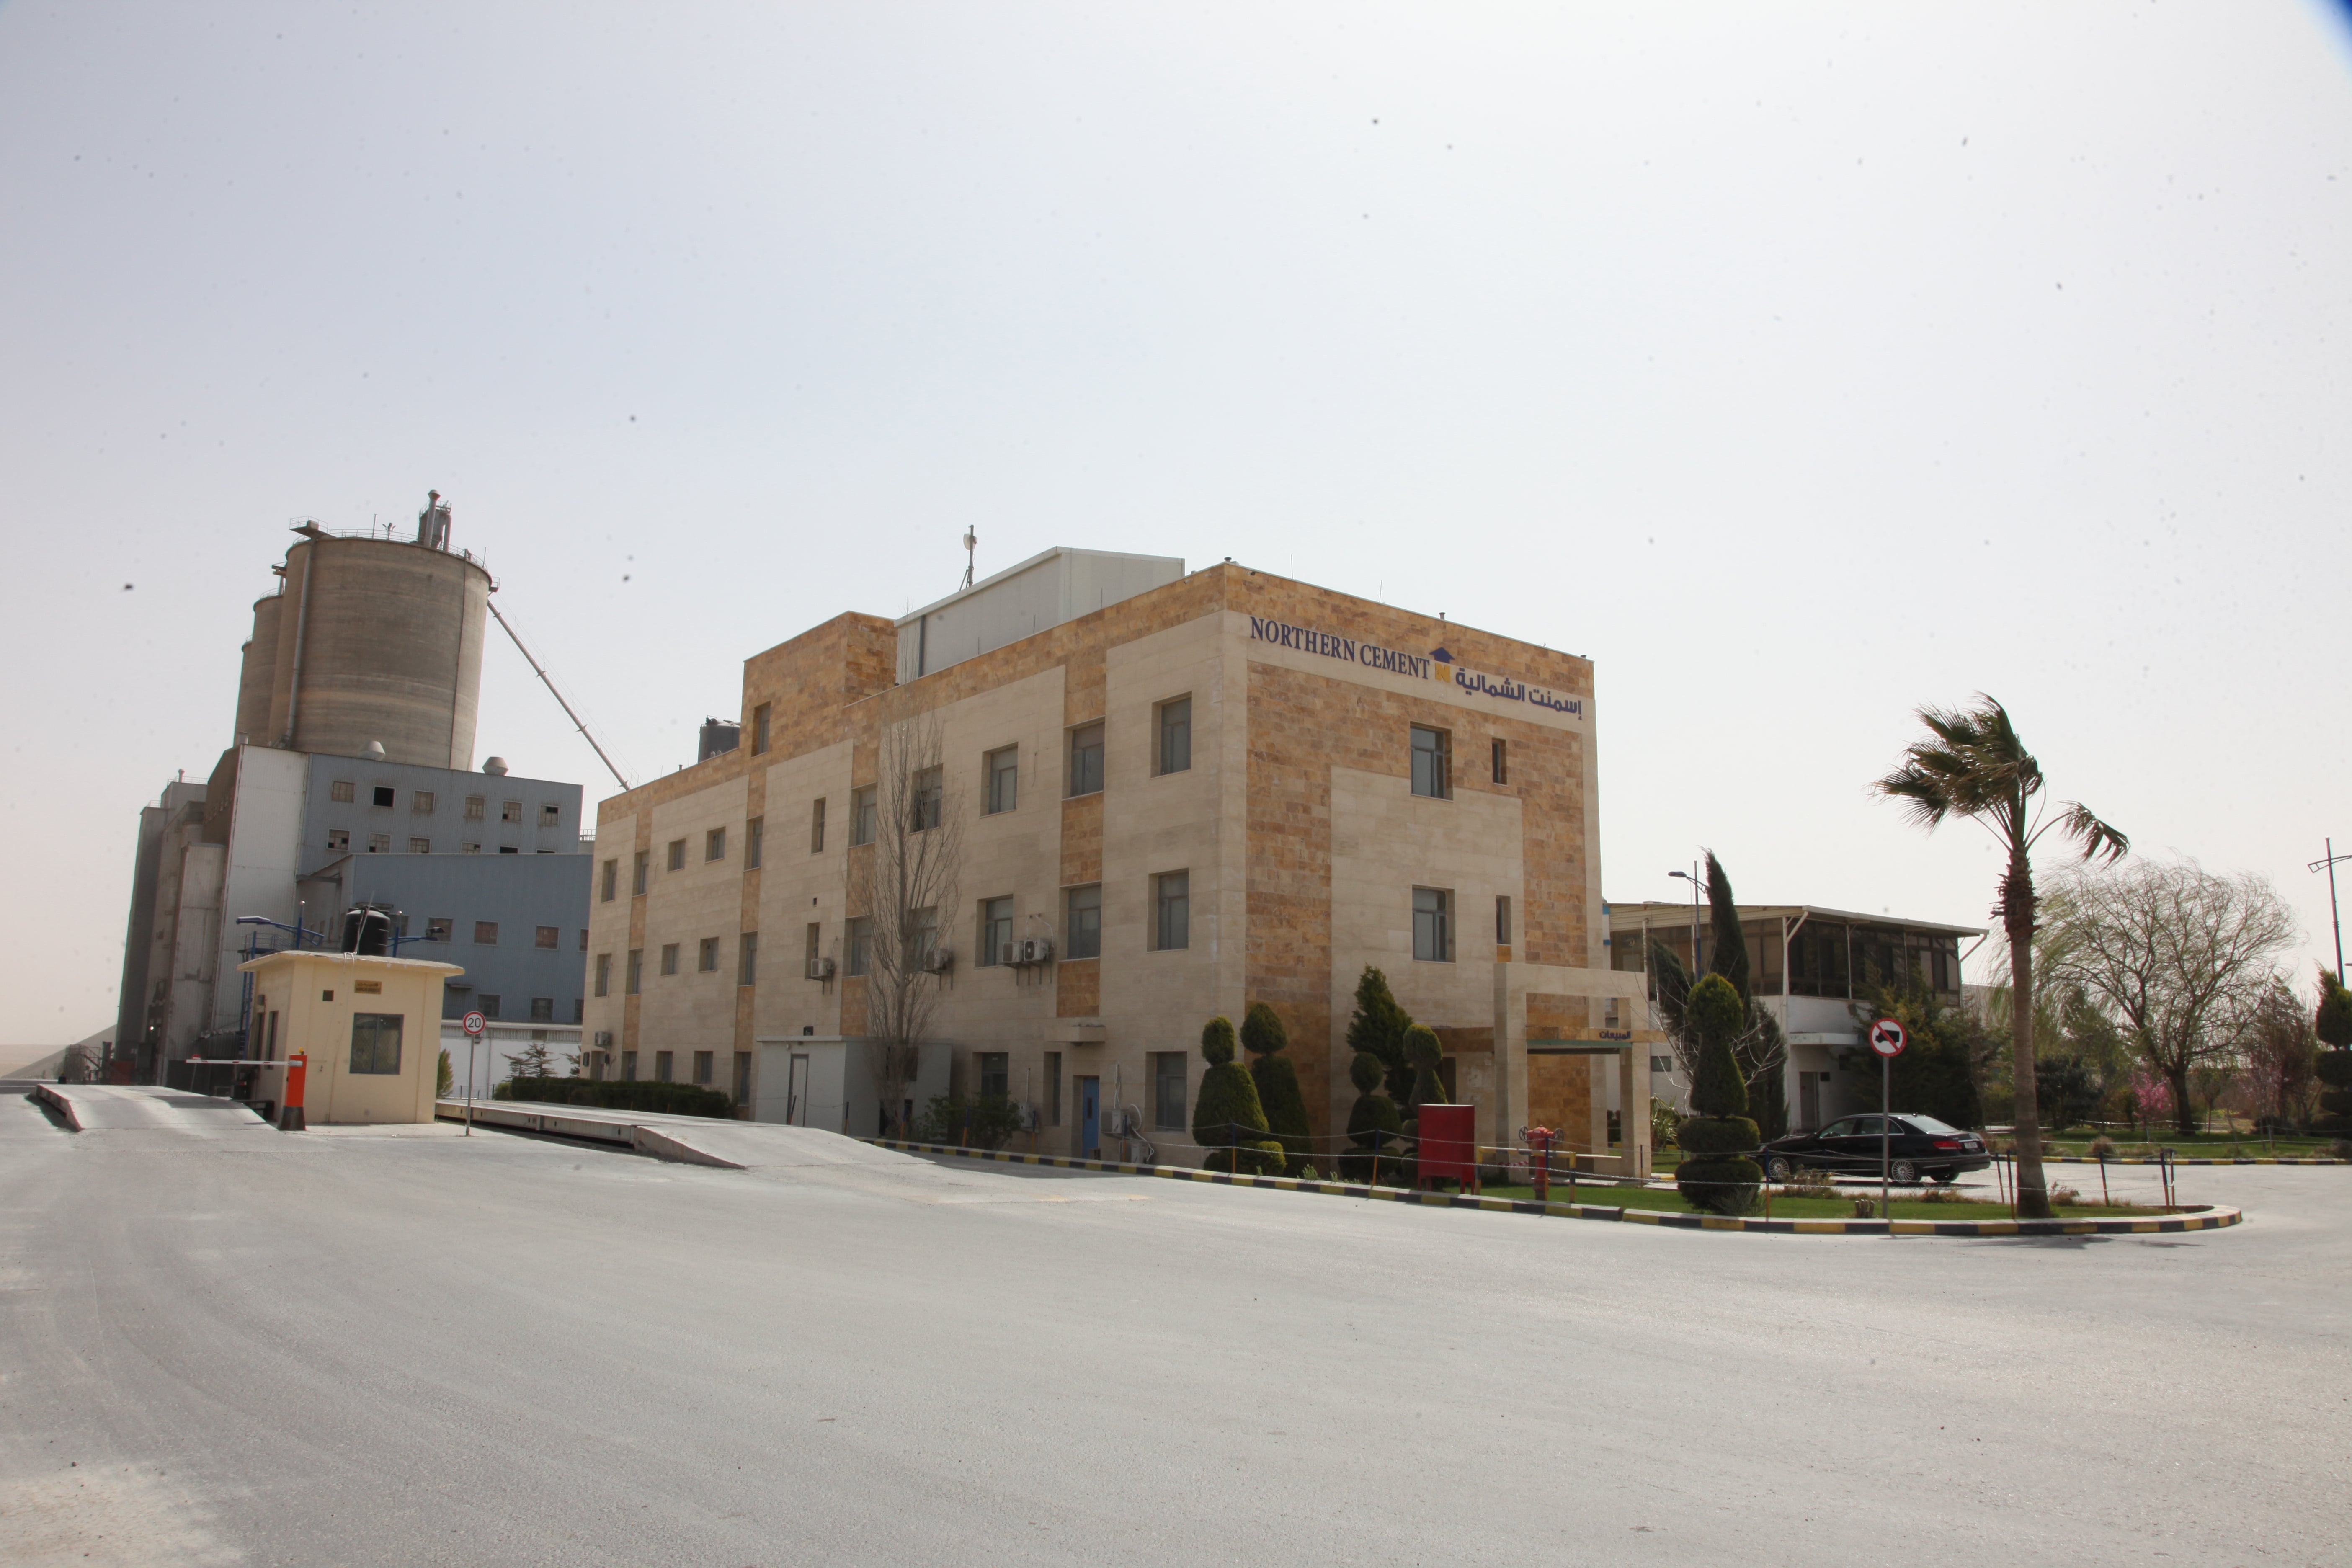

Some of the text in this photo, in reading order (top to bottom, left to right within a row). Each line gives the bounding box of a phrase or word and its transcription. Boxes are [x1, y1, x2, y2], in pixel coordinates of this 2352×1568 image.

[1250, 616, 1430, 679] NORTHERN CEMENT
[1455, 667, 1582, 720] إسمنت الشمالية
[468, 1017, 481, 1028] 20
[1599, 1030, 1631, 1041] المبيعات
